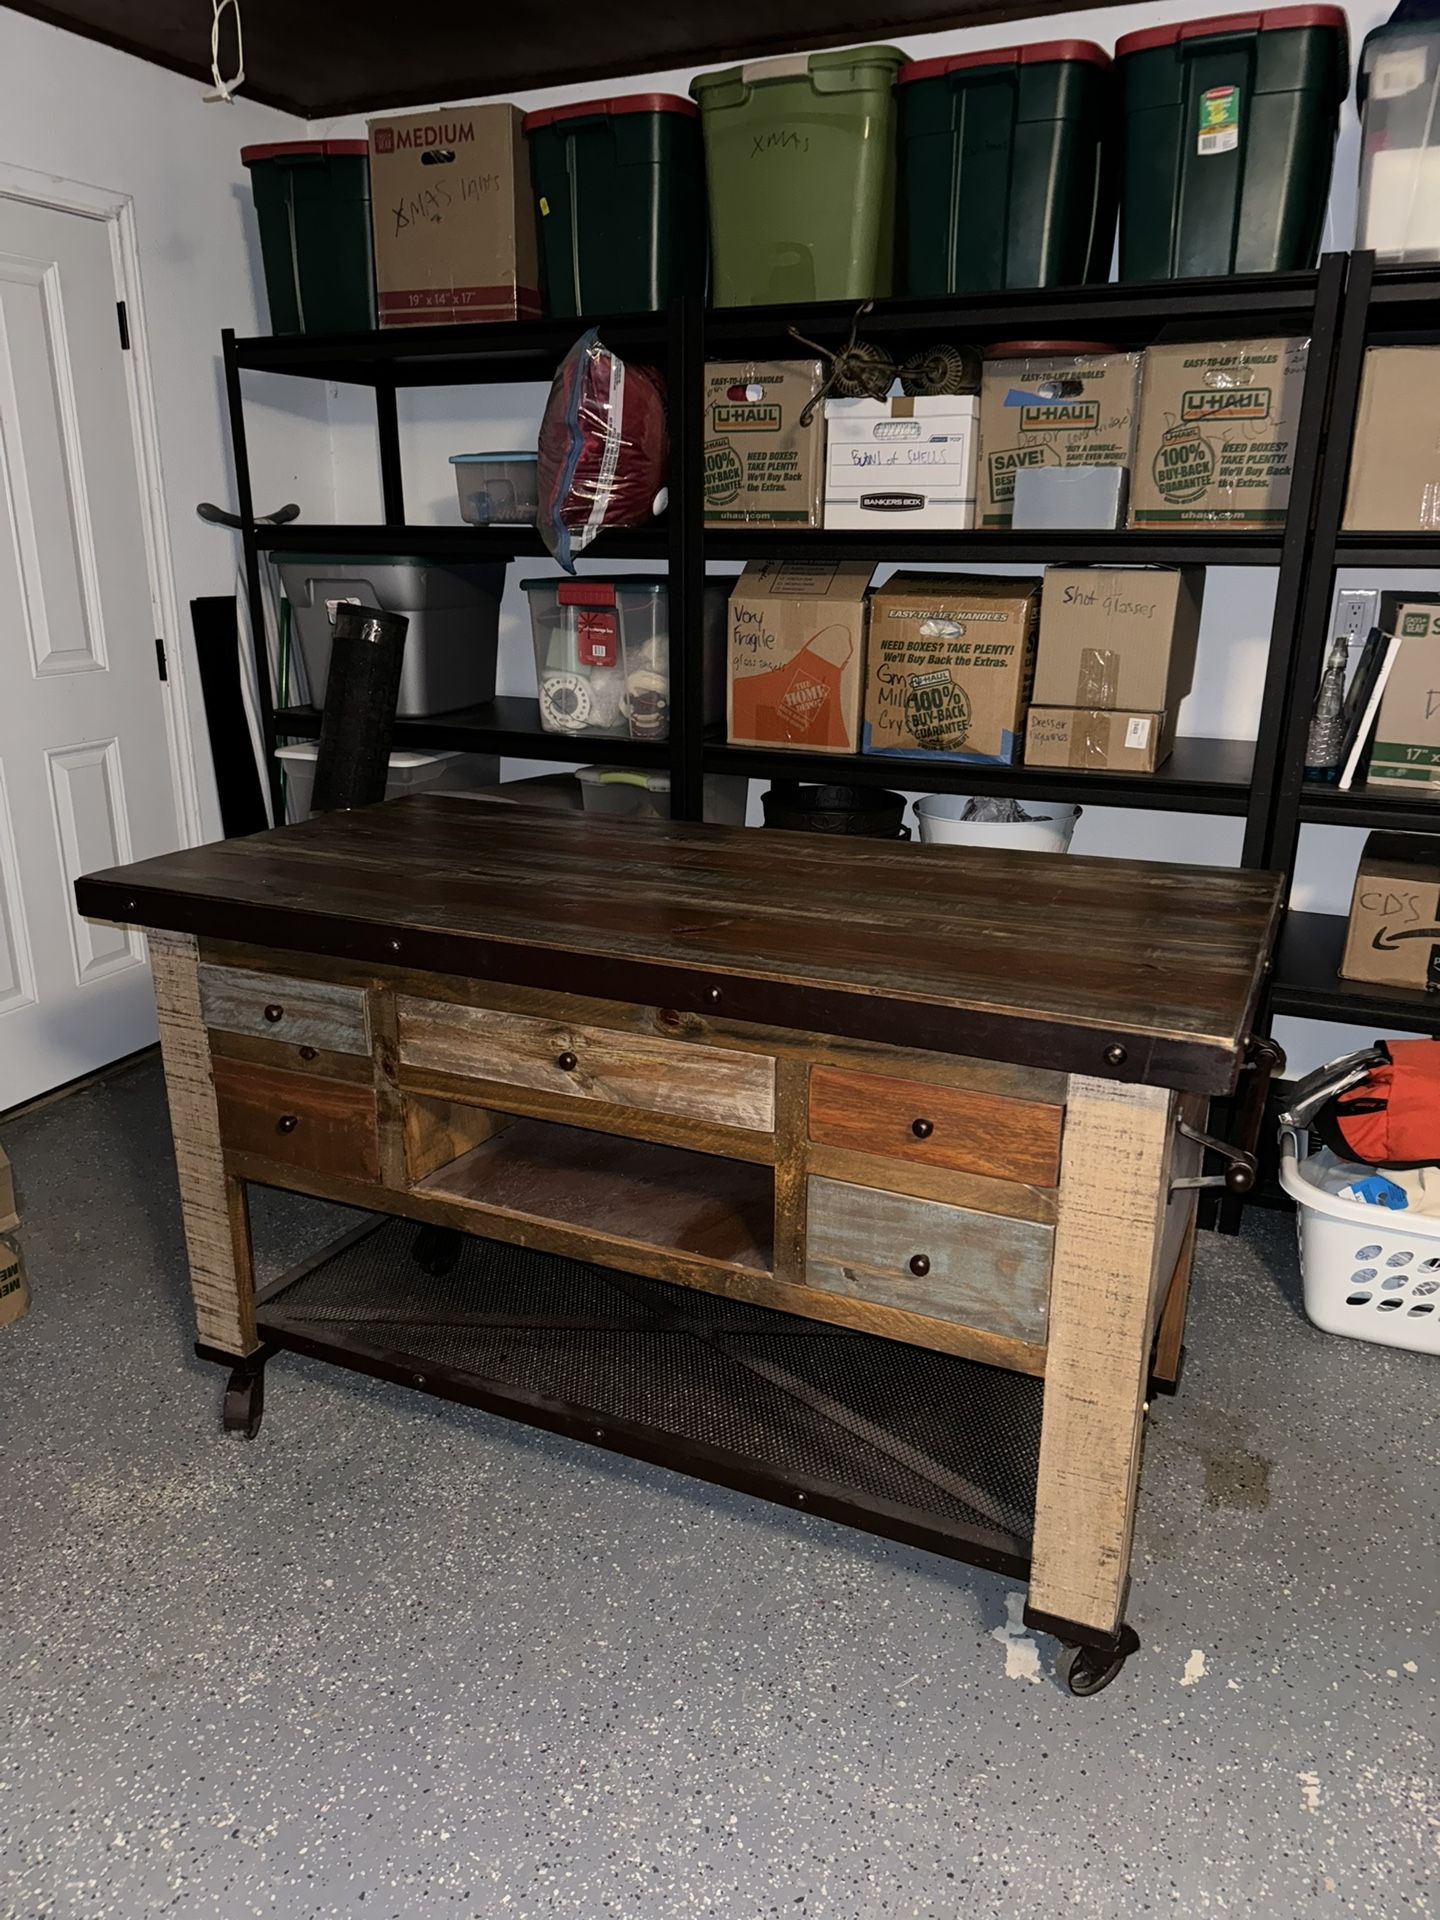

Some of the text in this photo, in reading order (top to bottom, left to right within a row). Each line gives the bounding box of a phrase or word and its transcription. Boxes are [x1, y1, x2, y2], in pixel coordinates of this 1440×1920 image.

[396, 121, 475, 150] MEDIUM
[1187, 392, 1265, 409] U-HAUL
[717, 408, 777, 422] U-HAUL
[1026, 405, 1095, 420] U-HAUL
[747, 451, 798, 460] NEED BOXES?
[1161, 442, 1205, 467] 100%
[1222, 442, 1289, 453] NEED BOXES?
[747, 462, 798, 471] TAKE PLENTY!
[994, 449, 1045, 471] SAVE!
[1221, 454, 1287, 464] TAKE PLENTY!
[704, 467, 740, 485] UY-BACK
[767, 473, 782, 483] Buy
[783, 473, 802, 481] Back
[1158, 461, 1210, 482] BUY-BACK
[1245, 467, 1264, 478] Buy
[1266, 466, 1291, 476] Back
[863, 498, 922, 506] BANKERS BOX
[1062, 585, 1100, 607] Shot
[889, 609, 1009, 622] EASY-TO-LIFT HANDLES
[733, 624, 775, 653] Fragile
[880, 640, 1015, 656] NEED BOXES? TAKE PLENTY!
[883, 652, 1009, 668] We'll Buy Back the Extras.
[785, 685, 825, 706] HOME
[912, 685, 961, 713] 100%
[911, 704, 966, 728] BUY-BACK
[1406, 747, 1429, 761] 17"
